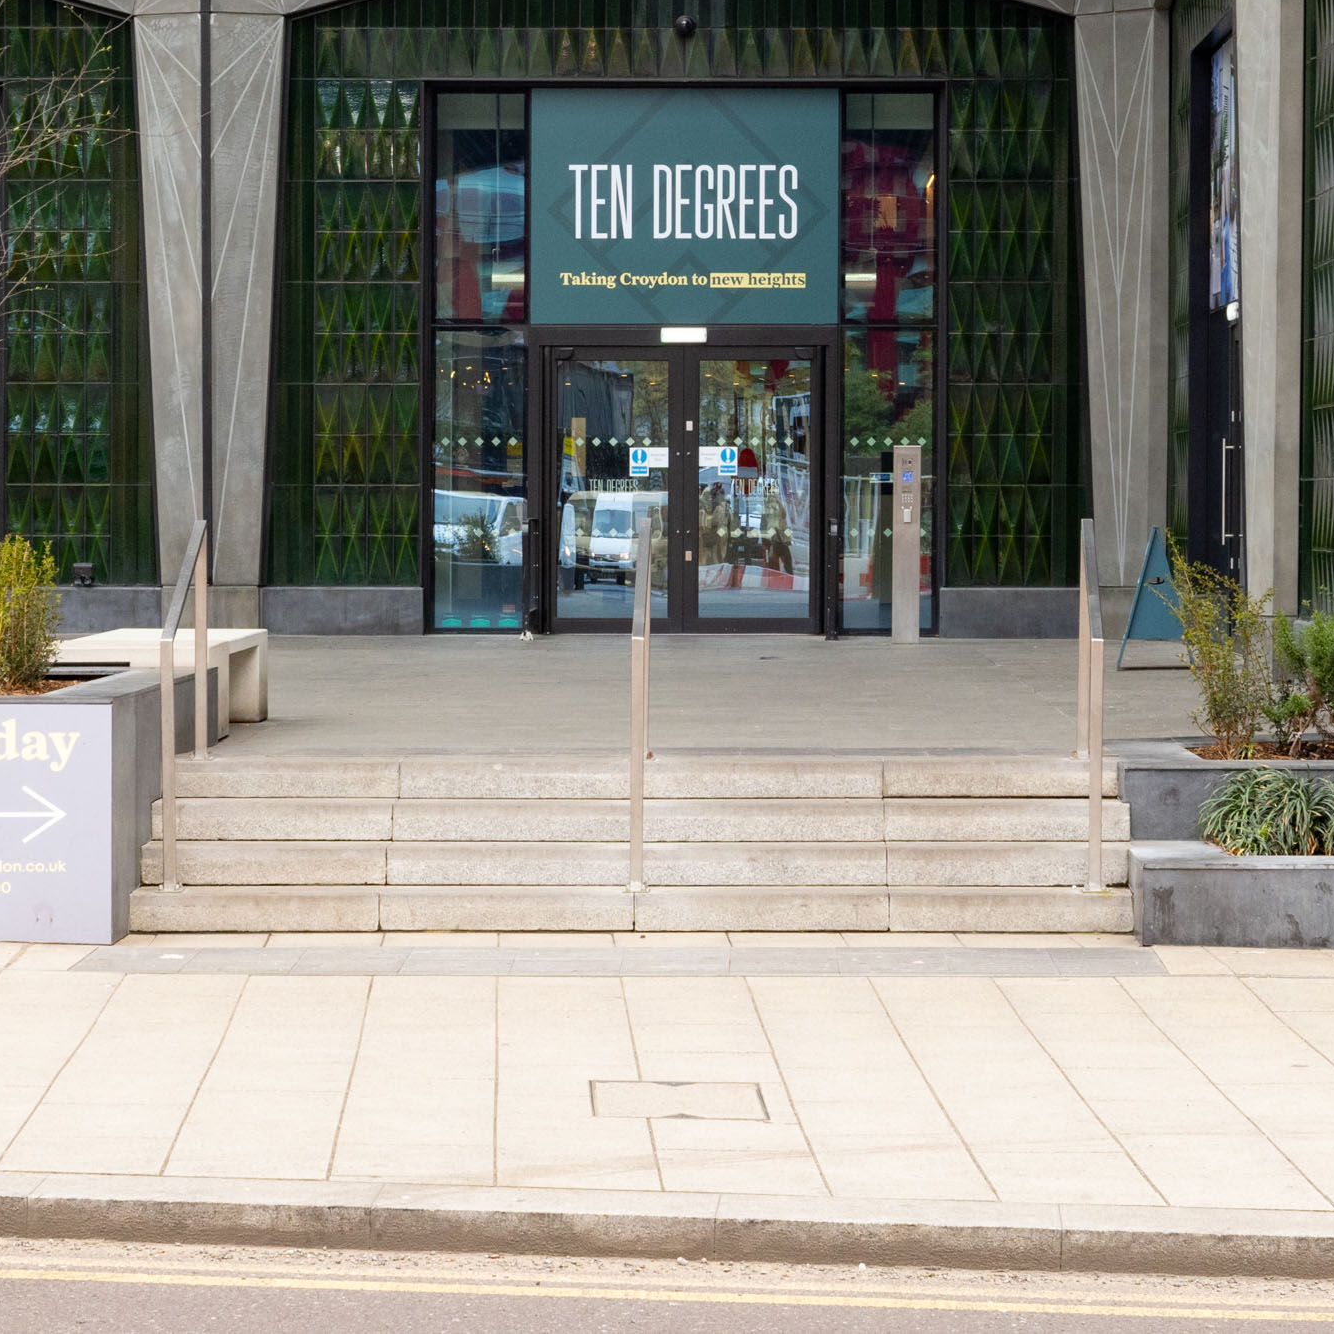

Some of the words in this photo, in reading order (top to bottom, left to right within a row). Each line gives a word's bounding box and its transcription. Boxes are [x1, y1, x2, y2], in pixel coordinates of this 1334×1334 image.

[568, 164, 633, 240] TEN
[653, 164, 798, 240] DEGREES
[560, 272, 617, 289] Taking
[619, 272, 689, 289] Croydon
[691, 273, 708, 286] to
[711, 274, 744, 286] new
[748, 273, 806, 288] heights
[589, 478, 603, 493] TEN
